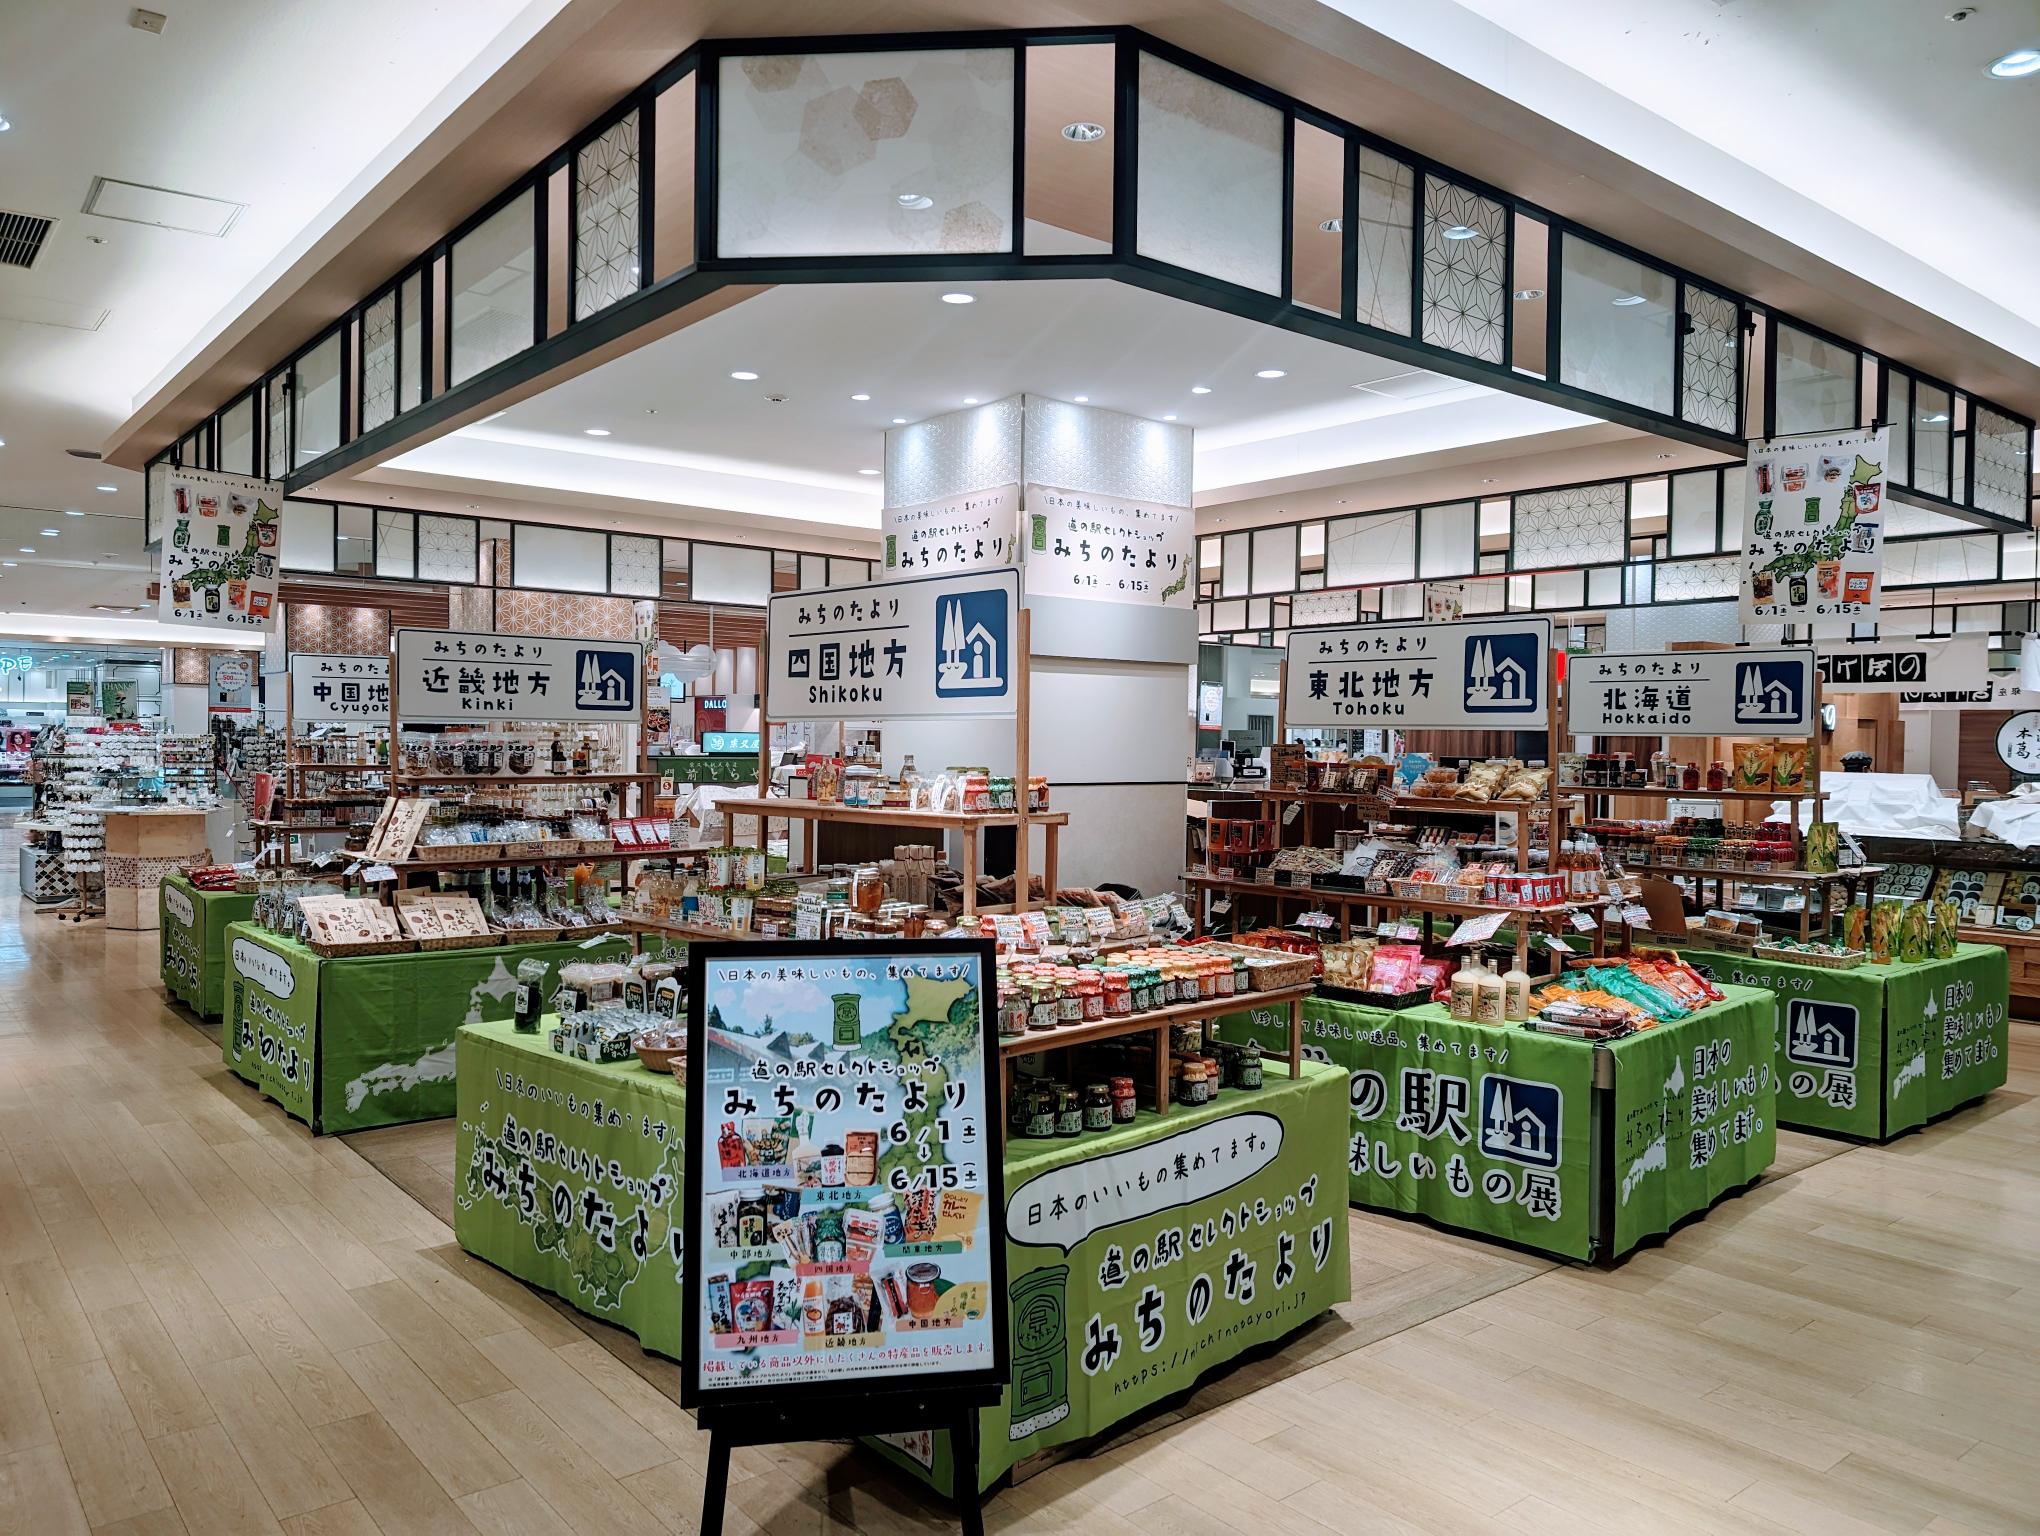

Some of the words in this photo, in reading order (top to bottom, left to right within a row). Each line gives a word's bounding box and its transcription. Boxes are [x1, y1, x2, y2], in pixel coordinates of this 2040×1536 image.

[902, 537, 1002, 568] みちのたより
[1055, 538, 1177, 571] みちのたより
[1749, 538, 1875, 556] みちのたより
[168, 554, 274, 577] みちのたより
[798, 598, 899, 625] みちのたより
[433, 640, 542, 660] みちのたより
[1319, 636, 1427, 655] みちのたより
[788, 639, 907, 681] 四国地方
[1599, 661, 1700, 676] みちのたより
[313, 682, 389, 702] 中国地
[422, 666, 551, 697] 近畿地方
[1308, 668, 1434, 700] 東北地方
[462, 697, 514, 711] Kinki
[808, 685, 882, 703] Shikoku
[1603, 685, 1692, 712] 北海道
[1333, 702, 1405, 715] Tohoku
[1602, 713, 1692, 724] Hokkaido
[728, 964, 961, 982] 日本の美味しいもの、集めてます
[1945, 980, 1974, 1009] 日本の
[1258, 1011, 1497, 1063] 珍して美味しい逸品、集めてます
[752, 1057, 940, 1080] 道の駅セレクトショップ
[1693, 1041, 1731, 1076] 日本の
[723, 1081, 966, 1116] みちのたより
[1692, 1065, 1768, 1123] 美味しいもの
[1690, 1107, 1762, 1166] 集めてます。
[503, 1116, 667, 1205] 道の駅セレクトショップ
[738, 1168, 791, 1179] 北海道地方
[1028, 1132, 1267, 1226] 日本のいいもの集めてます。
[816, 1189, 862, 1201] 東北地方
[1100, 1176, 1318, 1287] 道の駅セレクトショップ
[730, 1249, 772, 1260] 中部地方
[902, 1244, 943, 1254] 関東地方
[814, 1264, 853, 1274] 四国地方
[1085, 1221, 1333, 1371] みちのたより
[908, 1318, 952, 1329] 中国地方
[737, 1334, 779, 1345] 九州地方
[825, 1337, 867, 1348] 近畿地方
